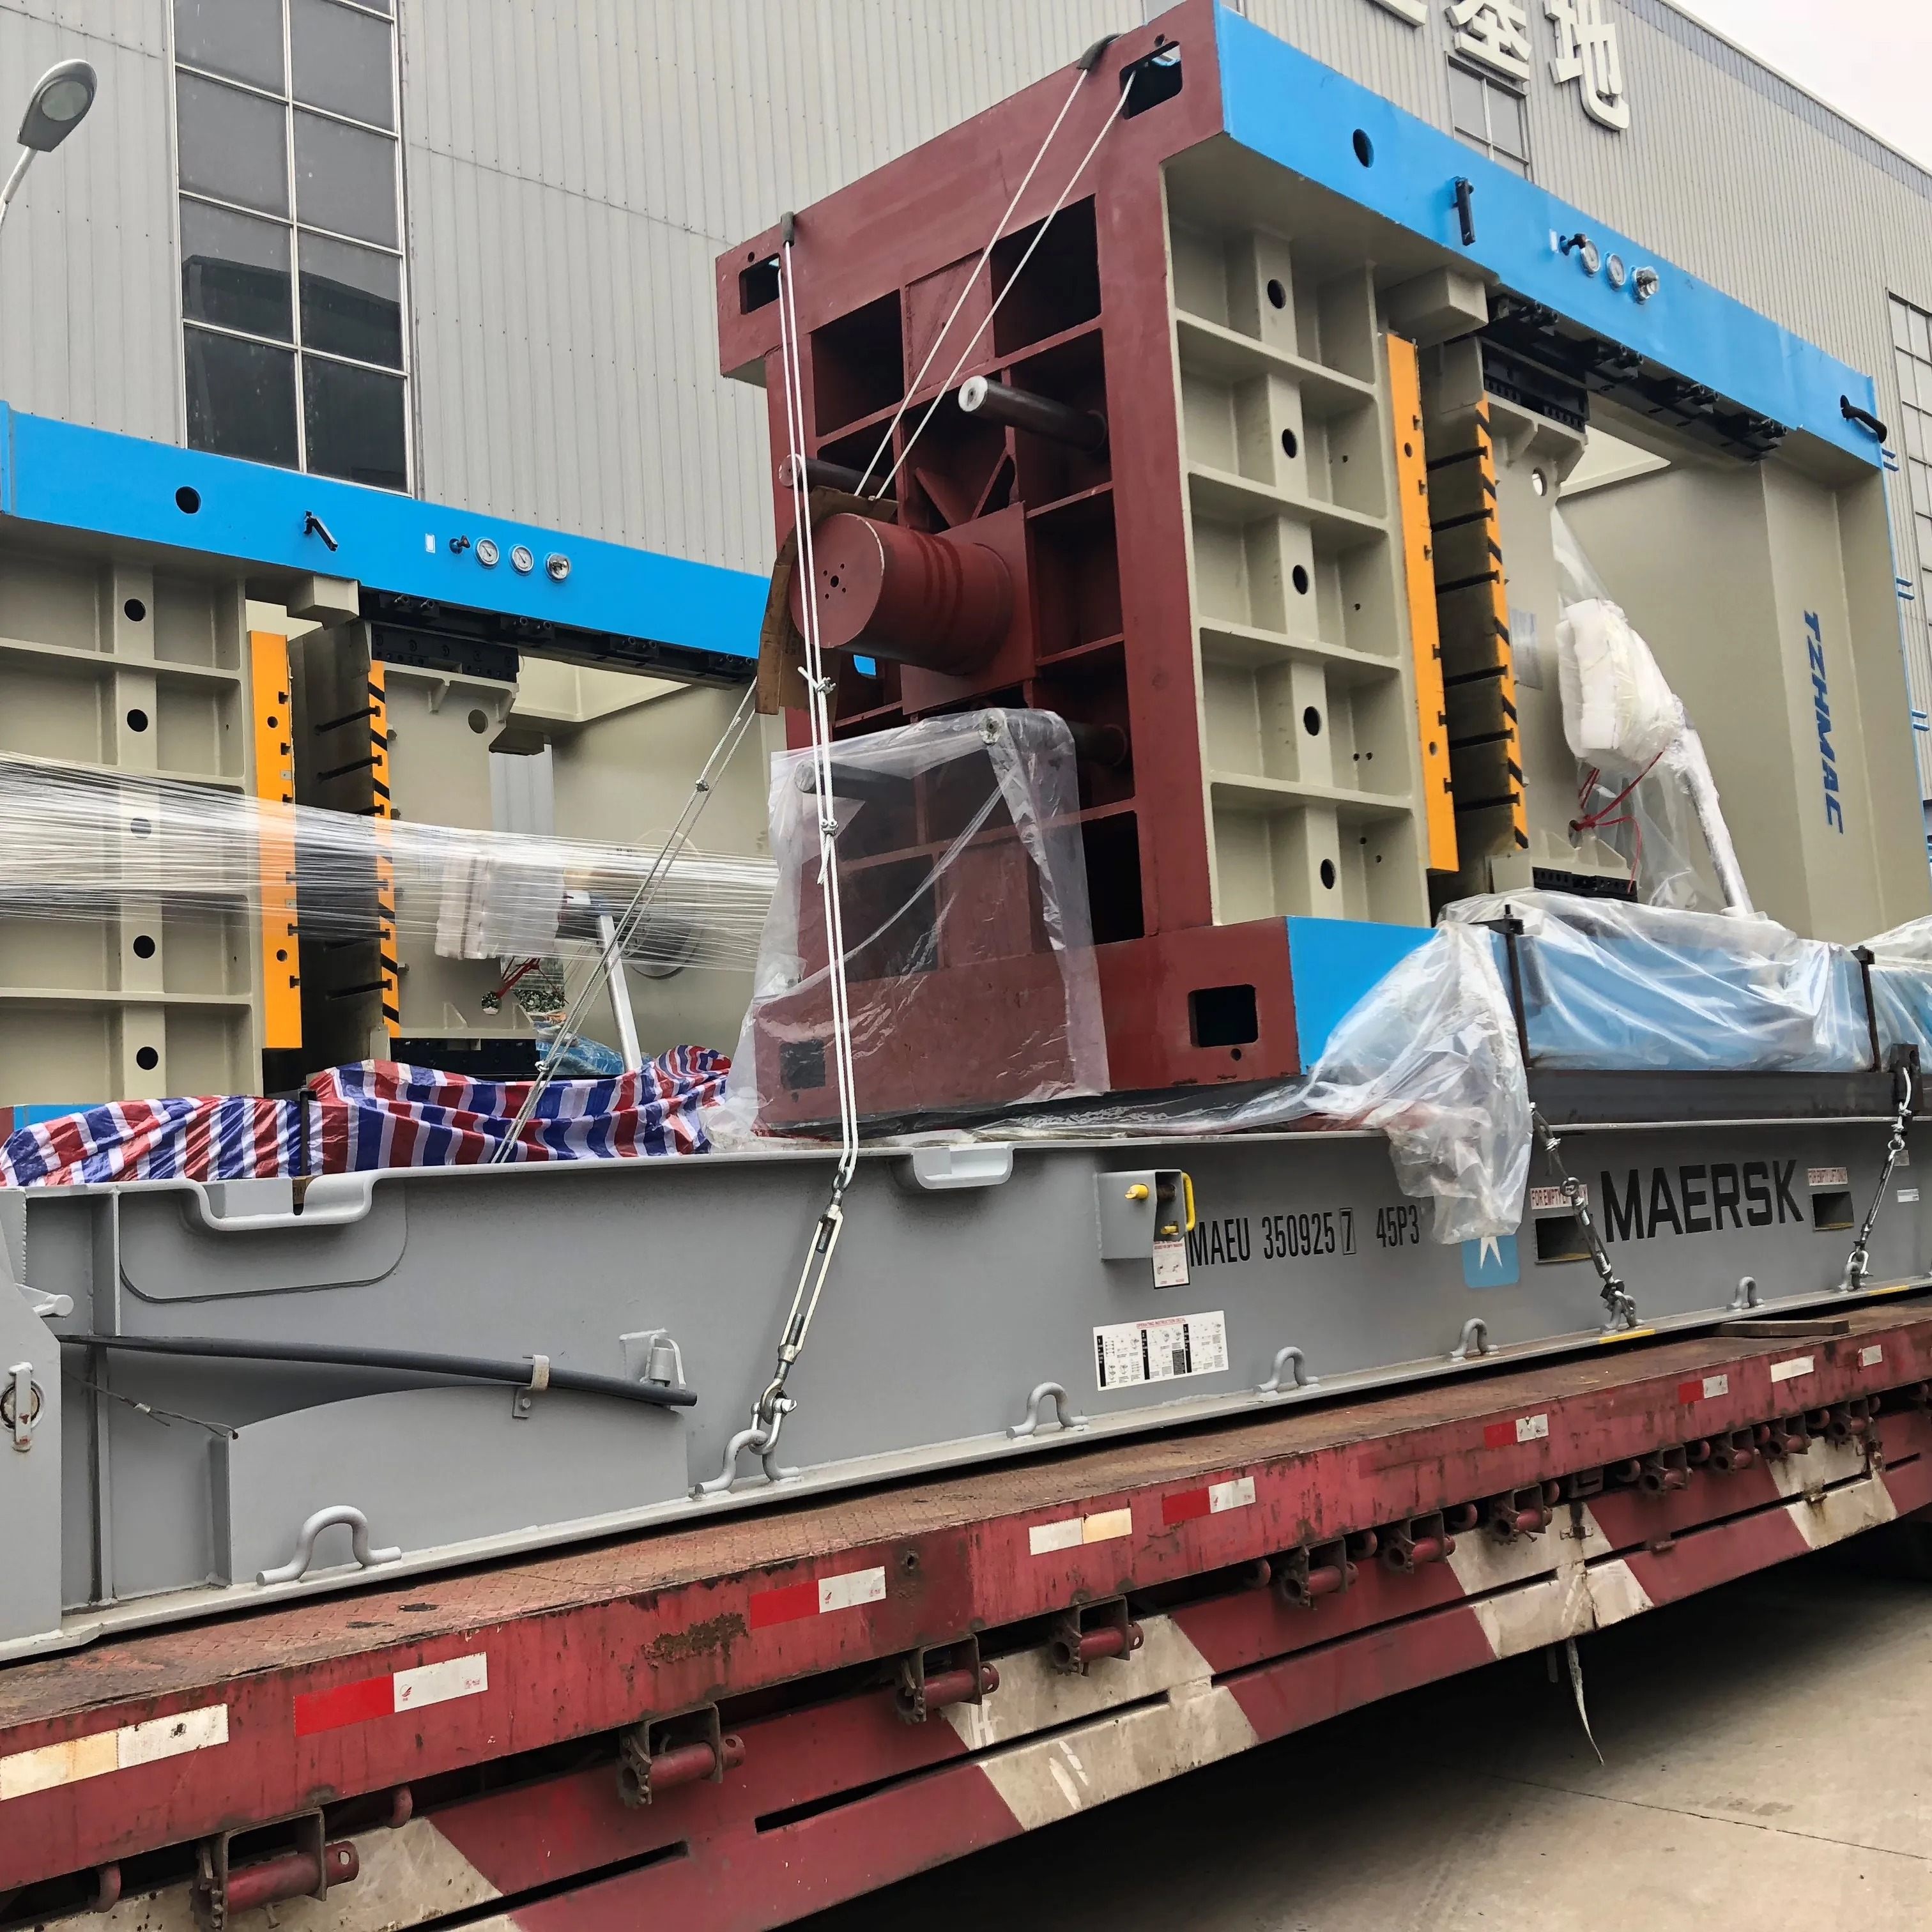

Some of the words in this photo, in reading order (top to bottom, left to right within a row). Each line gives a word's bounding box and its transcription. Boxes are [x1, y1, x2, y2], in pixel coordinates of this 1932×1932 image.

[1804, 609, 1844, 834] TZHMAC
[1188, 1218, 1250, 1267] MAEU
[1262, 1212, 1335, 1260] 350925
[1376, 1204, 1420, 1248] 45P3
[1600, 1160, 1805, 1243] MAERSK
